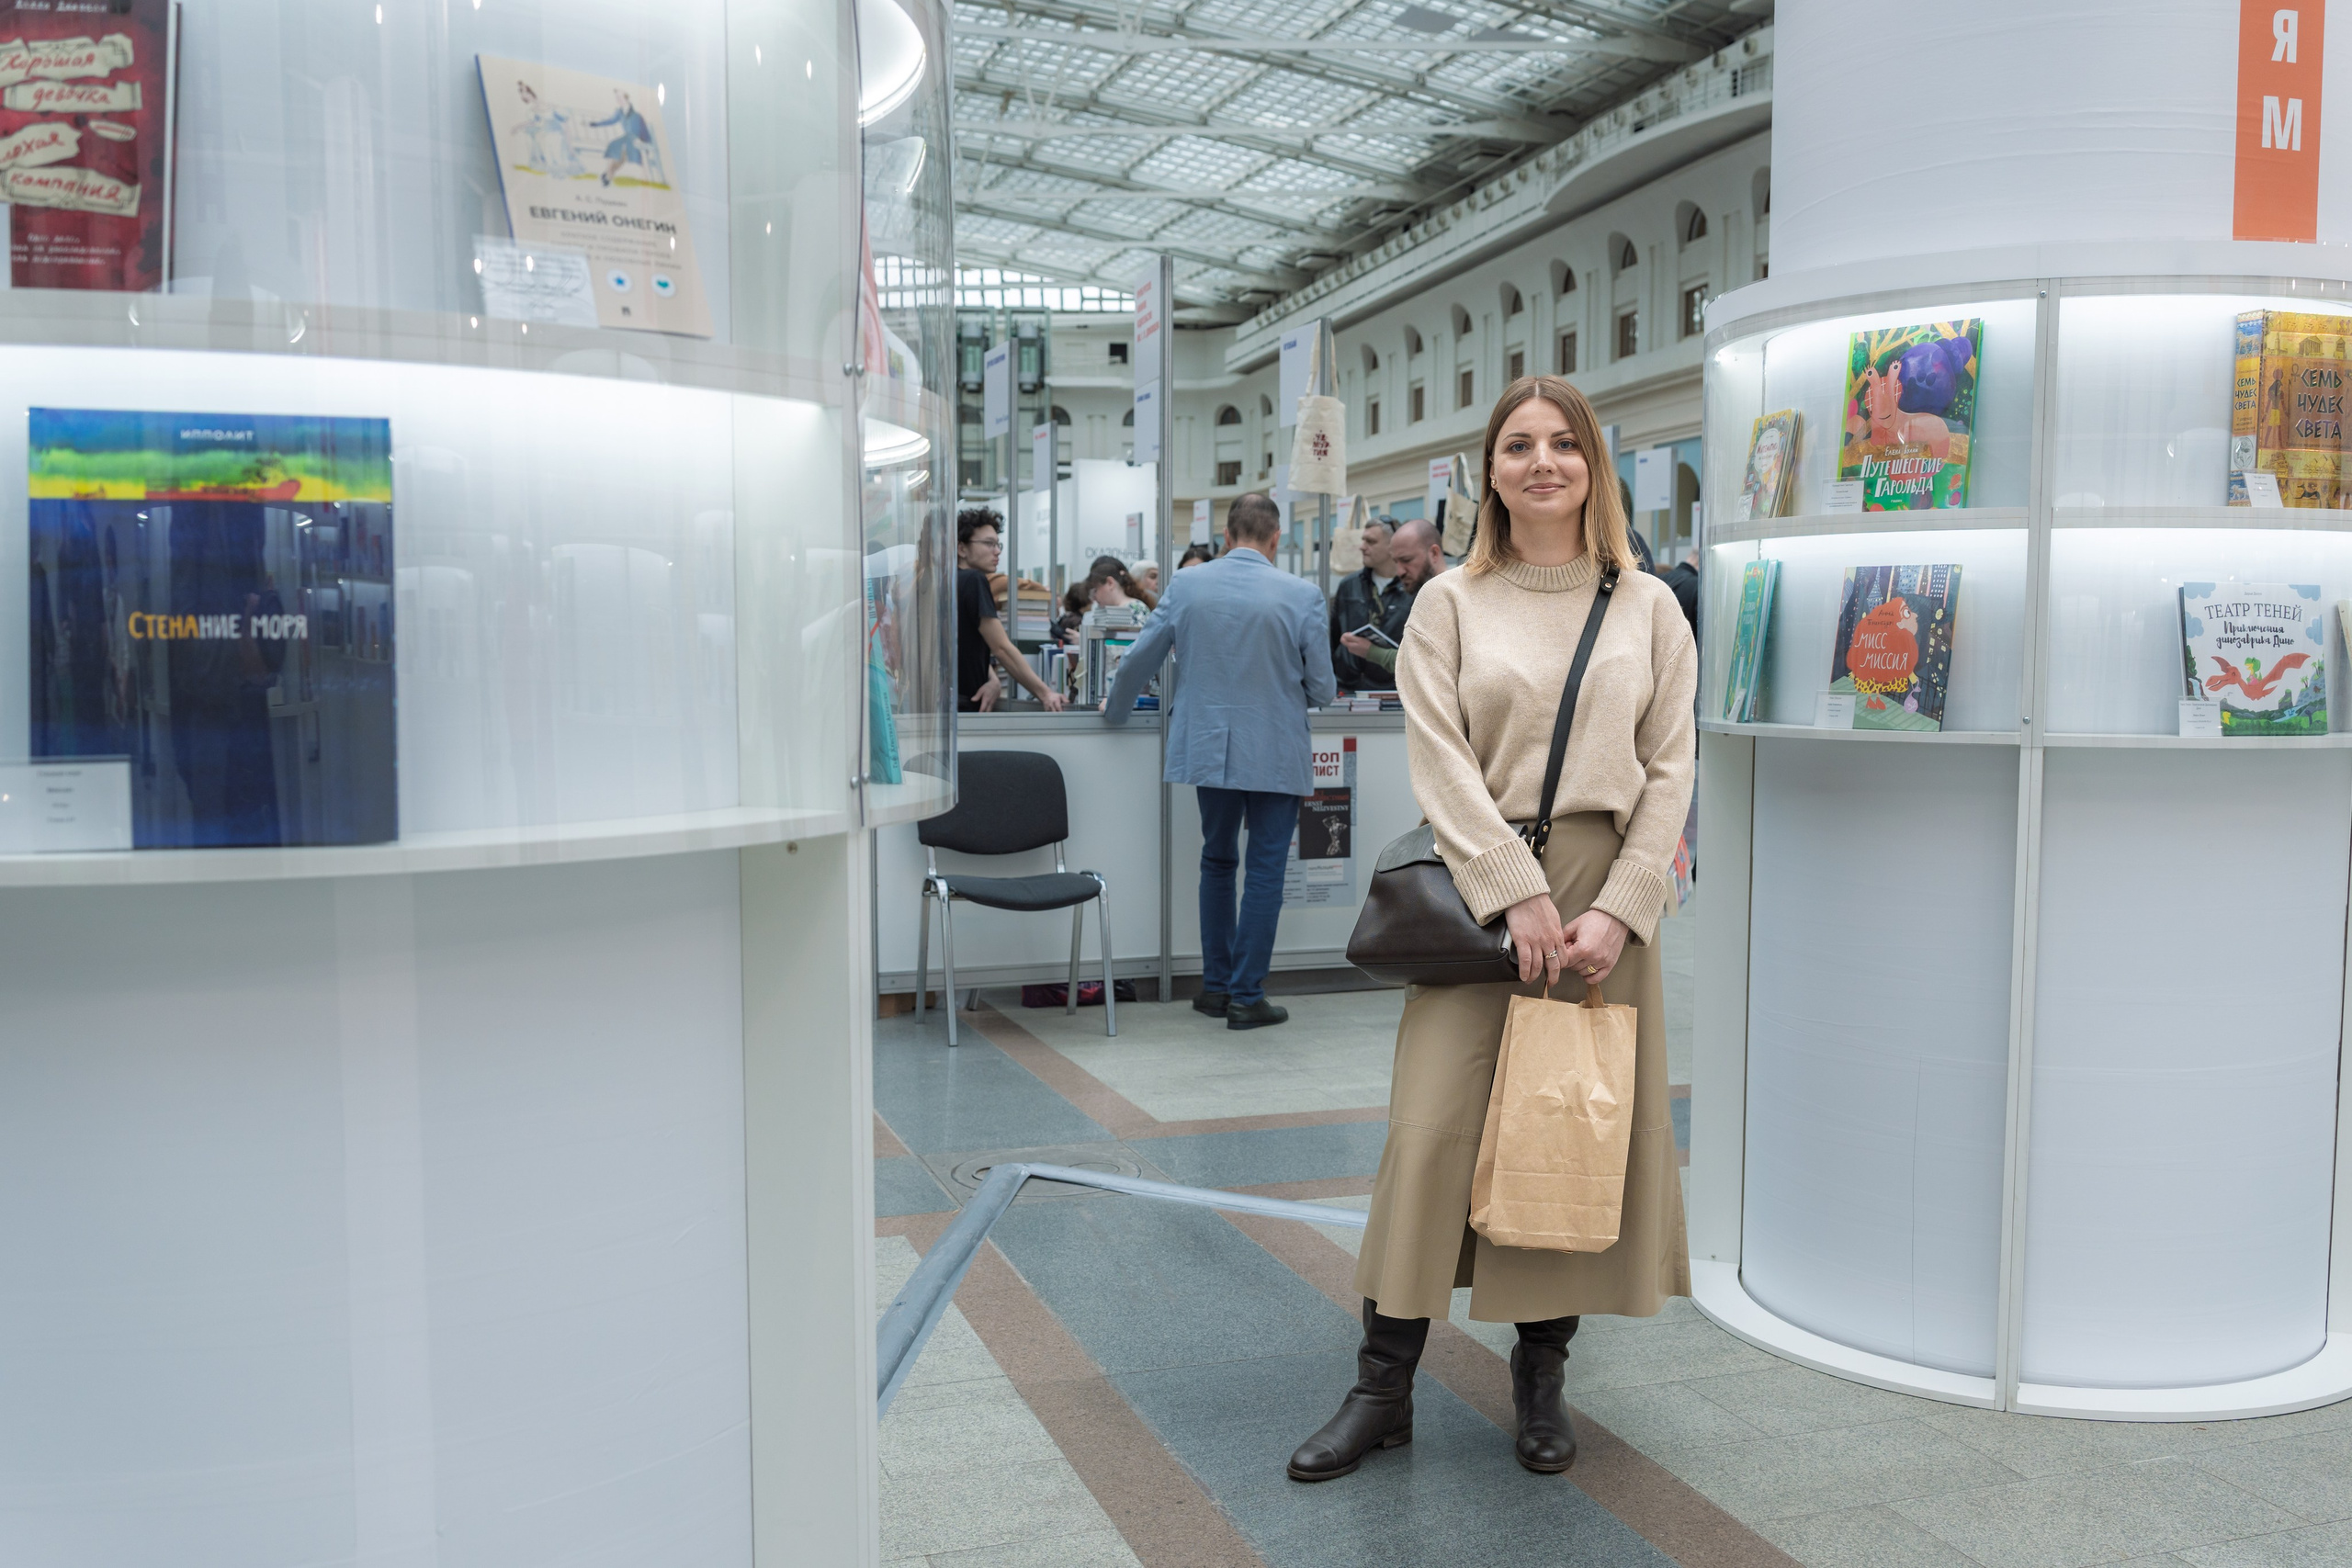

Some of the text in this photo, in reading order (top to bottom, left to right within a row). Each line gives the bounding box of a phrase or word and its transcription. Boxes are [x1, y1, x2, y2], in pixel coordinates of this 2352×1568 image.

[0, 51, 96, 77] Хорошая
[32, 86, 111, 110] девочка
[0, 130, 65, 164] лохая
[9, 173, 120, 202] компания
[529, 205, 678, 235] ЕВГЕНИЙ ОНЕГИН
[2237, 377, 2256, 388] СЕМЬ
[2300, 367, 2343, 389] СЕМЬ
[2235, 389, 2256, 399] ЧУДЕС
[2297, 392, 2345, 414] ЧУДЕС
[2234, 400, 2256, 411] СВЕТА
[180, 429, 254, 442] ИППОЛИТ
[2295, 418, 2343, 439] СВЕТА
[2204, 603, 2303, 622] ТЕАТР ТЕНЕЙ
[251, 614, 308, 640] МОРЯ
[2223, 620, 2285, 636] Приключения
[1854, 632, 1888, 649] МИСС
[2216, 633, 2295, 649] динозаврика Дино
[1860, 652, 1909, 671] МИССИЯ
